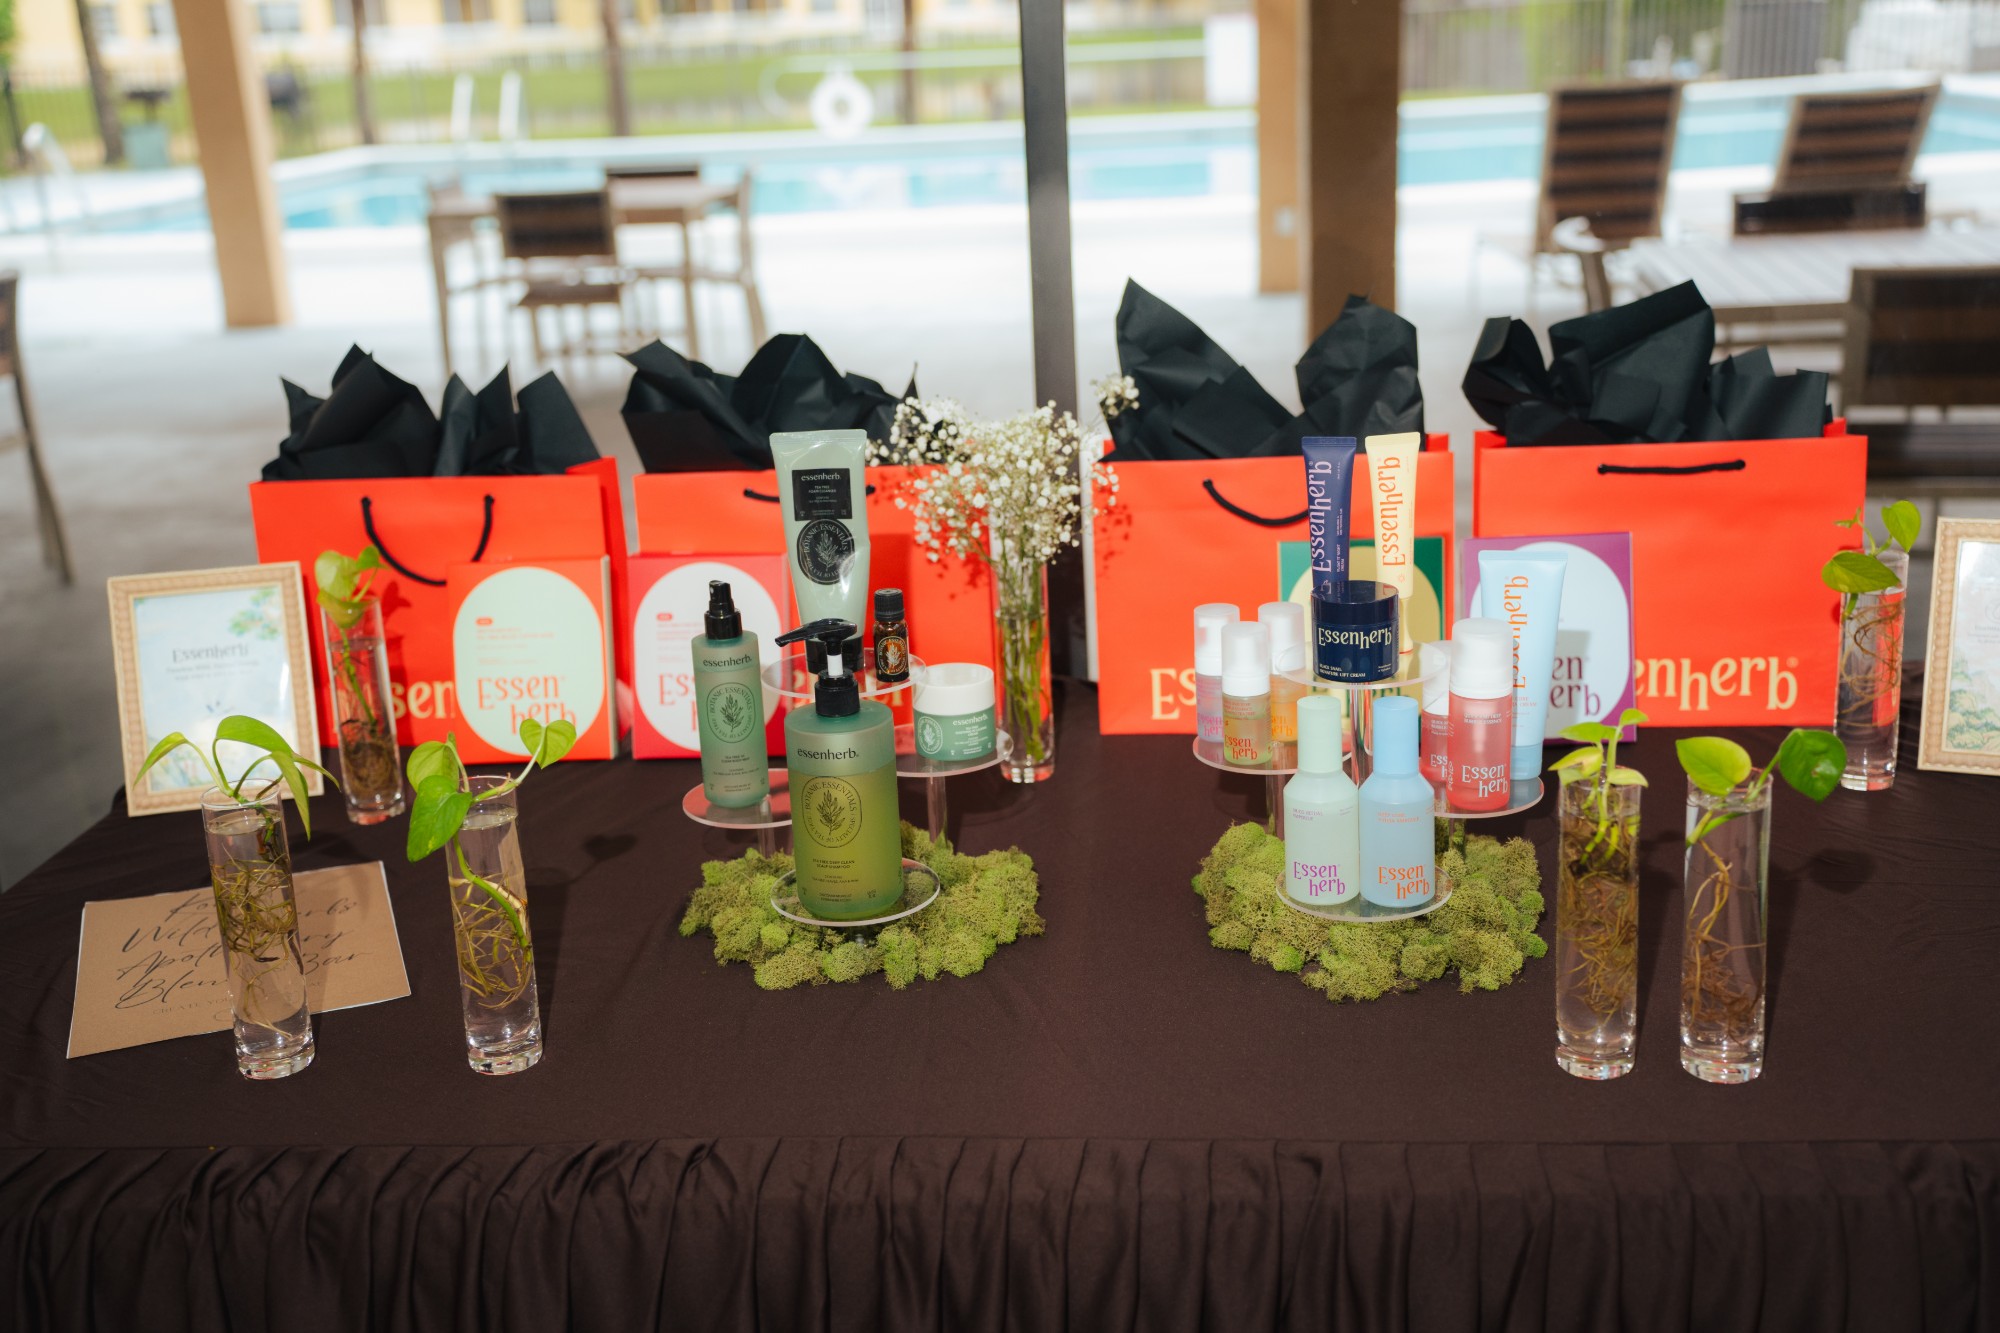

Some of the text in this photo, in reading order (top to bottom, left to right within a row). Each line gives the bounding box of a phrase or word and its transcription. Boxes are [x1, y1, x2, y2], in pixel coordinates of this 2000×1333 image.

[1308, 460, 1332, 573] Essenherb
[1378, 456, 1406, 566] Essenherb
[1318, 626, 1392, 649] Essenherb
[476, 675, 560, 710] Essen
[1462, 765, 1504, 783] Essen
[822, 781, 857, 812] ESSENTIALS
[1478, 777, 1508, 798] herb
[1294, 861, 1337, 880] Essen
[1378, 865, 1424, 885] Essen
[1309, 878, 1346, 896] herb
[1396, 879, 1430, 900] herb
